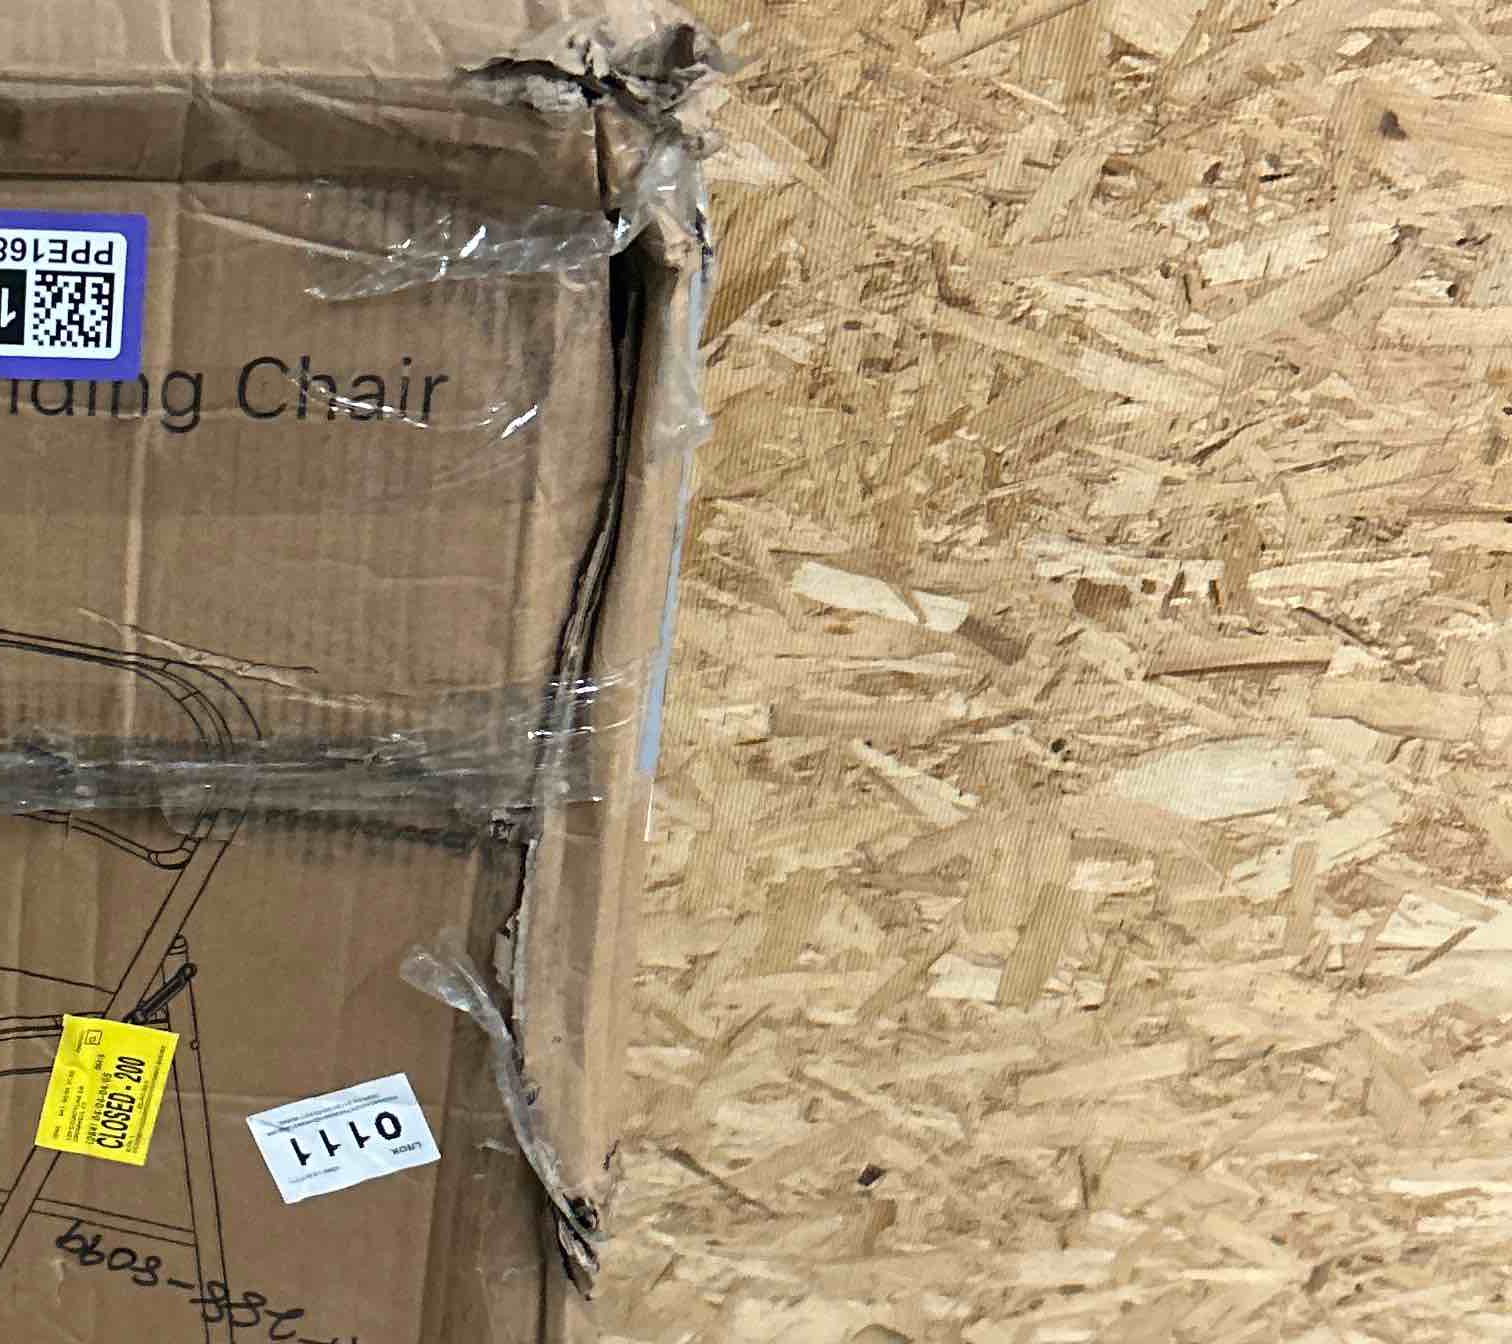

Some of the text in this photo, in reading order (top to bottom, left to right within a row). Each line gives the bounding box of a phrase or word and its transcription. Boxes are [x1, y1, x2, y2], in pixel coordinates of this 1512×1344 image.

[236, 355, 450, 426] Chair
[114, 1055, 146, 1083] 200
[96, 1092, 136, 1149] CLOSED
[289, 1111, 403, 1166] 0111
